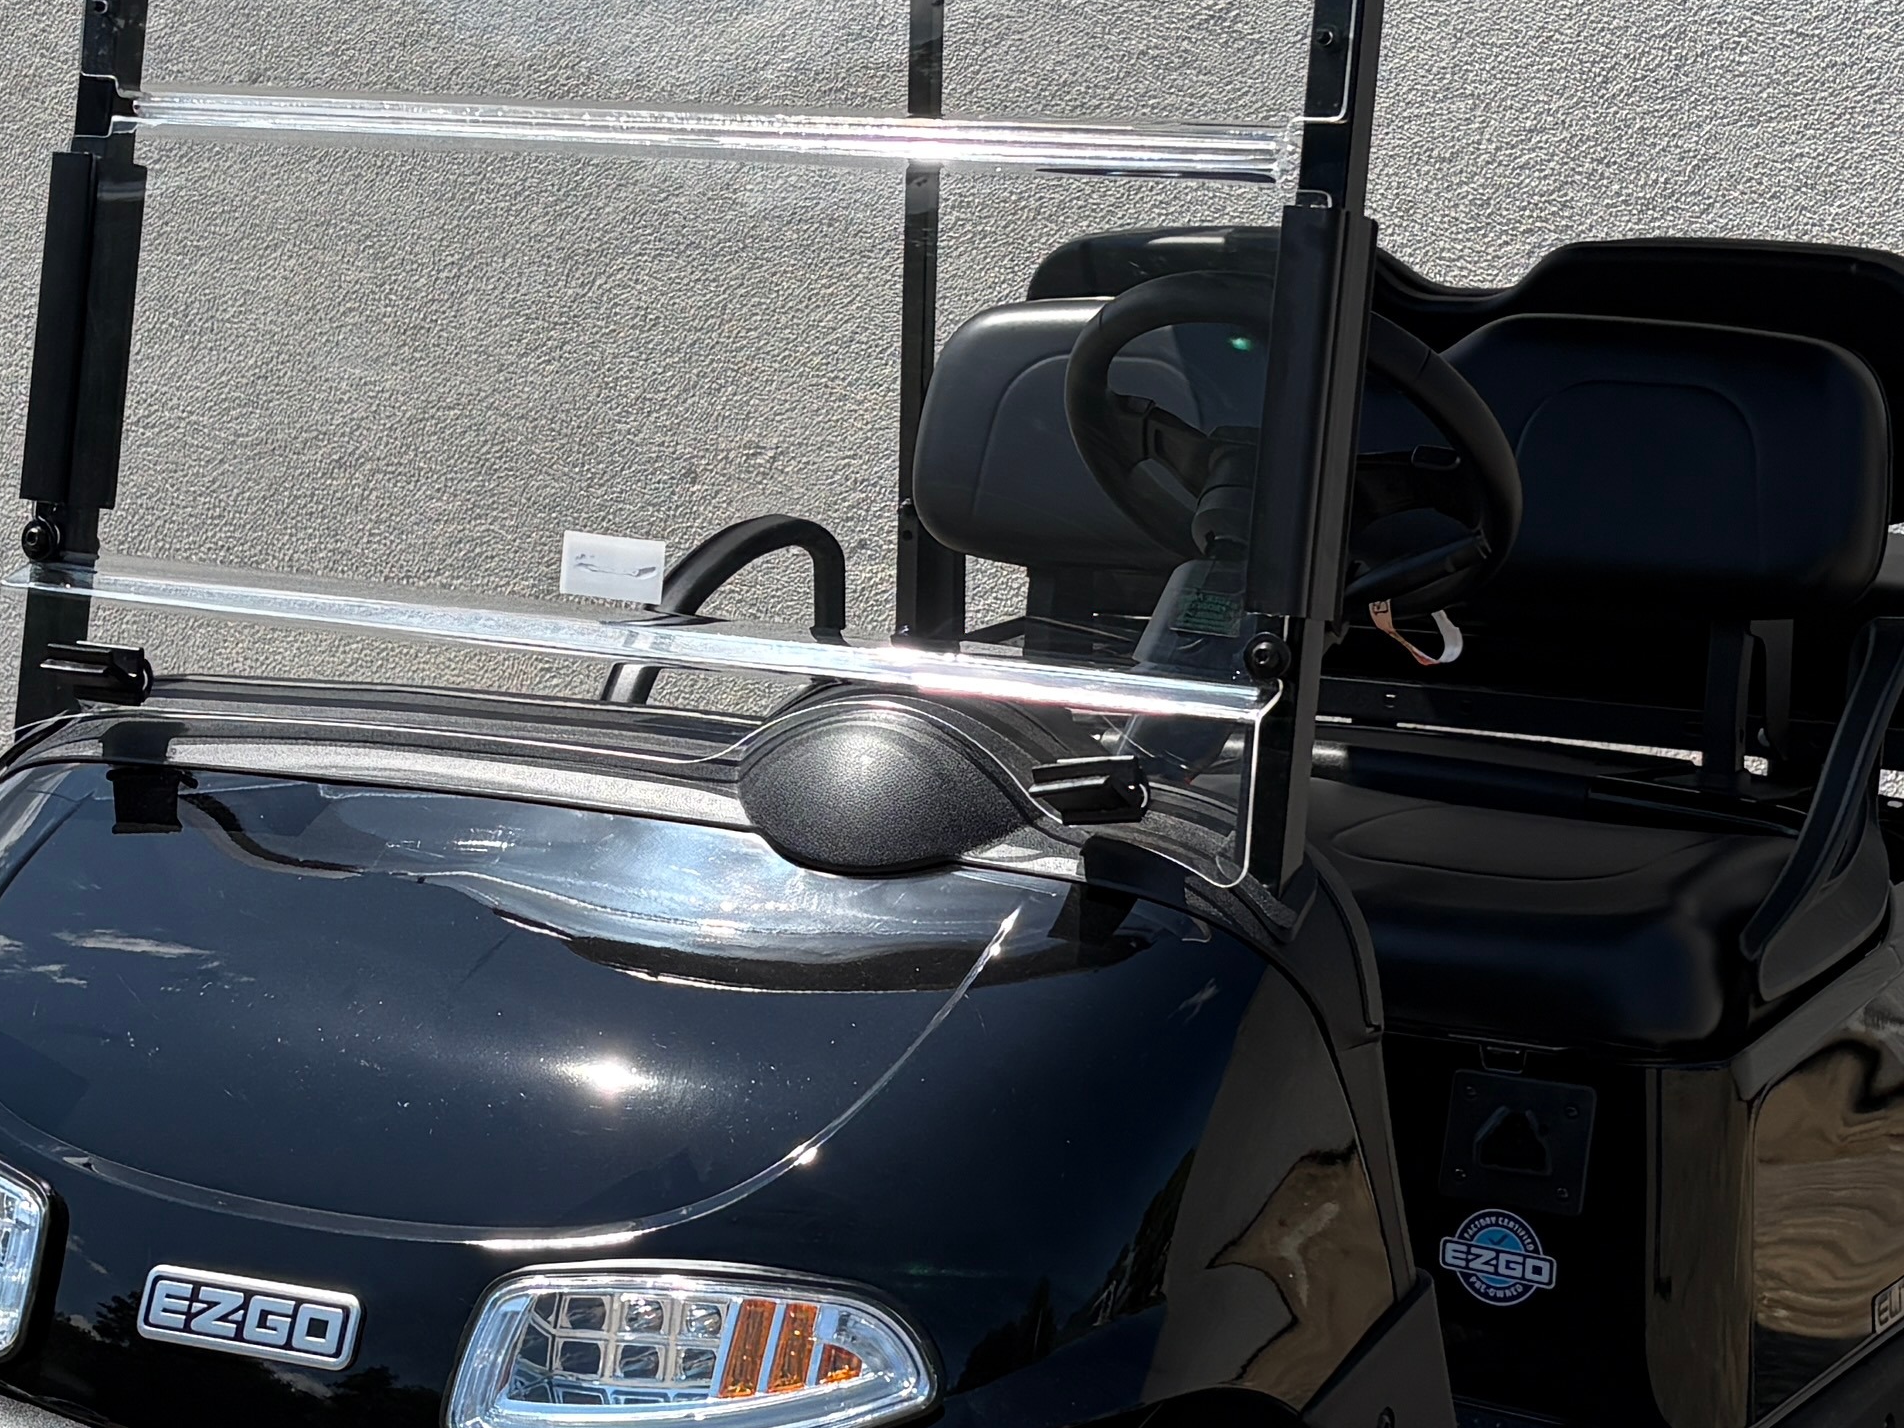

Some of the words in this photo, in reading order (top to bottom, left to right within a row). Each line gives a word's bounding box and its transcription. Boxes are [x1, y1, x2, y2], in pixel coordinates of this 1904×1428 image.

[1463, 1215, 1497, 1240] FACTORY
[1497, 1216, 1535, 1251] CERTIFIED
[1468, 1275, 1524, 1299] PRE-OWNED
